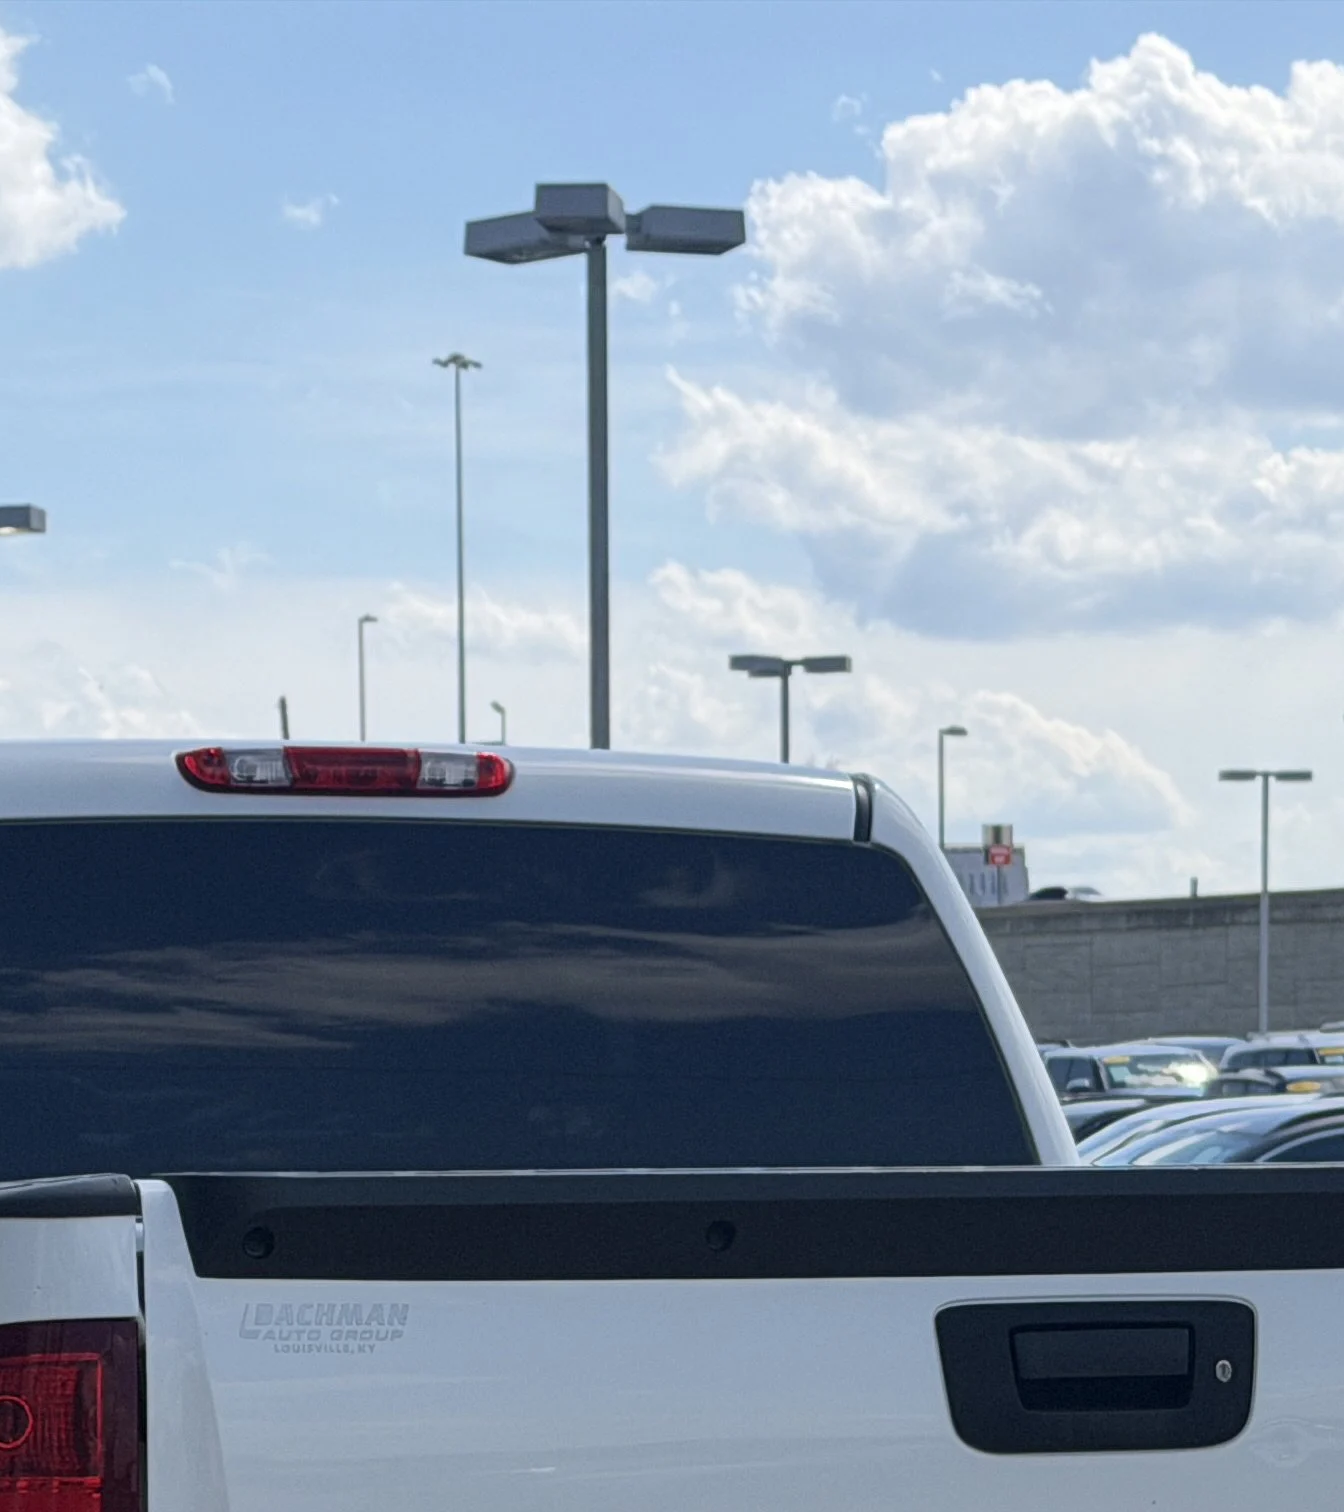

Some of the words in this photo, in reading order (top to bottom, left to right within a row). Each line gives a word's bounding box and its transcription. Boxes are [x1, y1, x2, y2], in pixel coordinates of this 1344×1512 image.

[253, 1303, 410, 1327] BACHMAN
[261, 1329, 322, 1342] AUTO
[330, 1329, 405, 1342] GROUP
